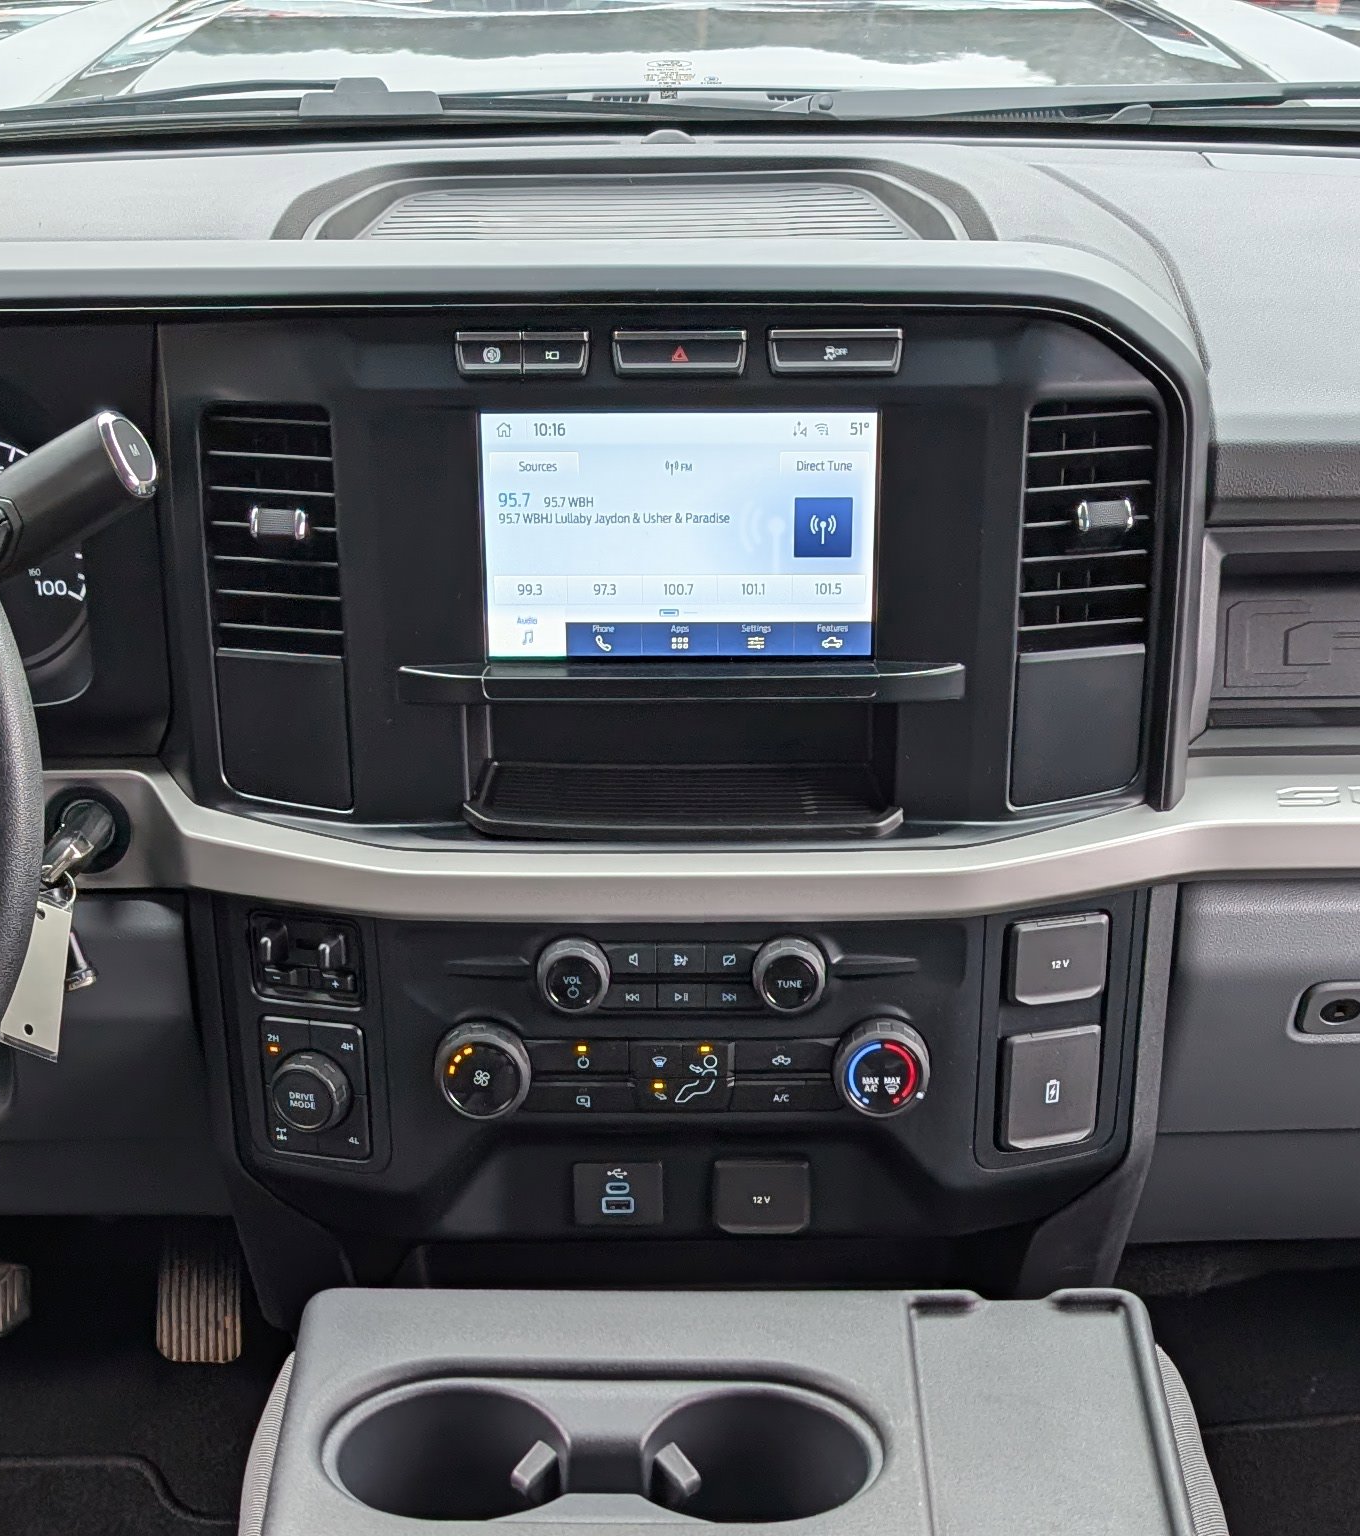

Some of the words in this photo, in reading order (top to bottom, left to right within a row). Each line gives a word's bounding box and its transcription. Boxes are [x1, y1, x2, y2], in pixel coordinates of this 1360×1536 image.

[533, 422, 566, 437] 10:16
[518, 460, 558, 473] Sources
[680, 462, 693, 472] FM
[796, 460, 825, 472] Direct
[827, 460, 853, 472] Tune
[498, 492, 531, 508] 95.7
[543, 496, 566, 508] 95.7
[567, 496, 594, 508] WBH
[498, 512, 521, 524] 95.7
[522, 512, 553, 524] WBHJ
[555, 512, 592, 526] Lullaby
[594, 512, 631, 526] Jaydon
[632, 513, 641, 524] &
[643, 512, 673, 524] Usher
[674, 513, 683, 524] &
[685, 512, 731, 524] Paradise
[34, 579, 68, 596] 100
[517, 583, 543, 596] 99.3
[593, 583, 617, 596] 97.3
[663, 583, 694, 596] 100.7
[741, 583, 766, 596] 101.1
[814, 583, 842, 596] 101.5
[516, 616, 538, 625] Audio
[592, 624, 615, 633] Phone
[670, 624, 690, 634] Apps
[741, 624, 772, 634] Settings
[816, 624, 849, 633] Features
[1051, 960, 1062, 969] 12
[562, 975, 582, 985] VOL
[777, 979, 803, 989] TUNE
[267, 1033, 280, 1042] 2H
[340, 1042, 354, 1051] 4H
[861, 1076, 879, 1085] MAX
[883, 1076, 901, 1085] MAX
[863, 1084, 878, 1093] A/C
[288, 1091, 315, 1102] DRIVE
[772, 1093, 790, 1102] A/C
[289, 1100, 316, 1110] MODE
[348, 1136, 360, 1145] 4L
[752, 1196, 763, 1204] 12
